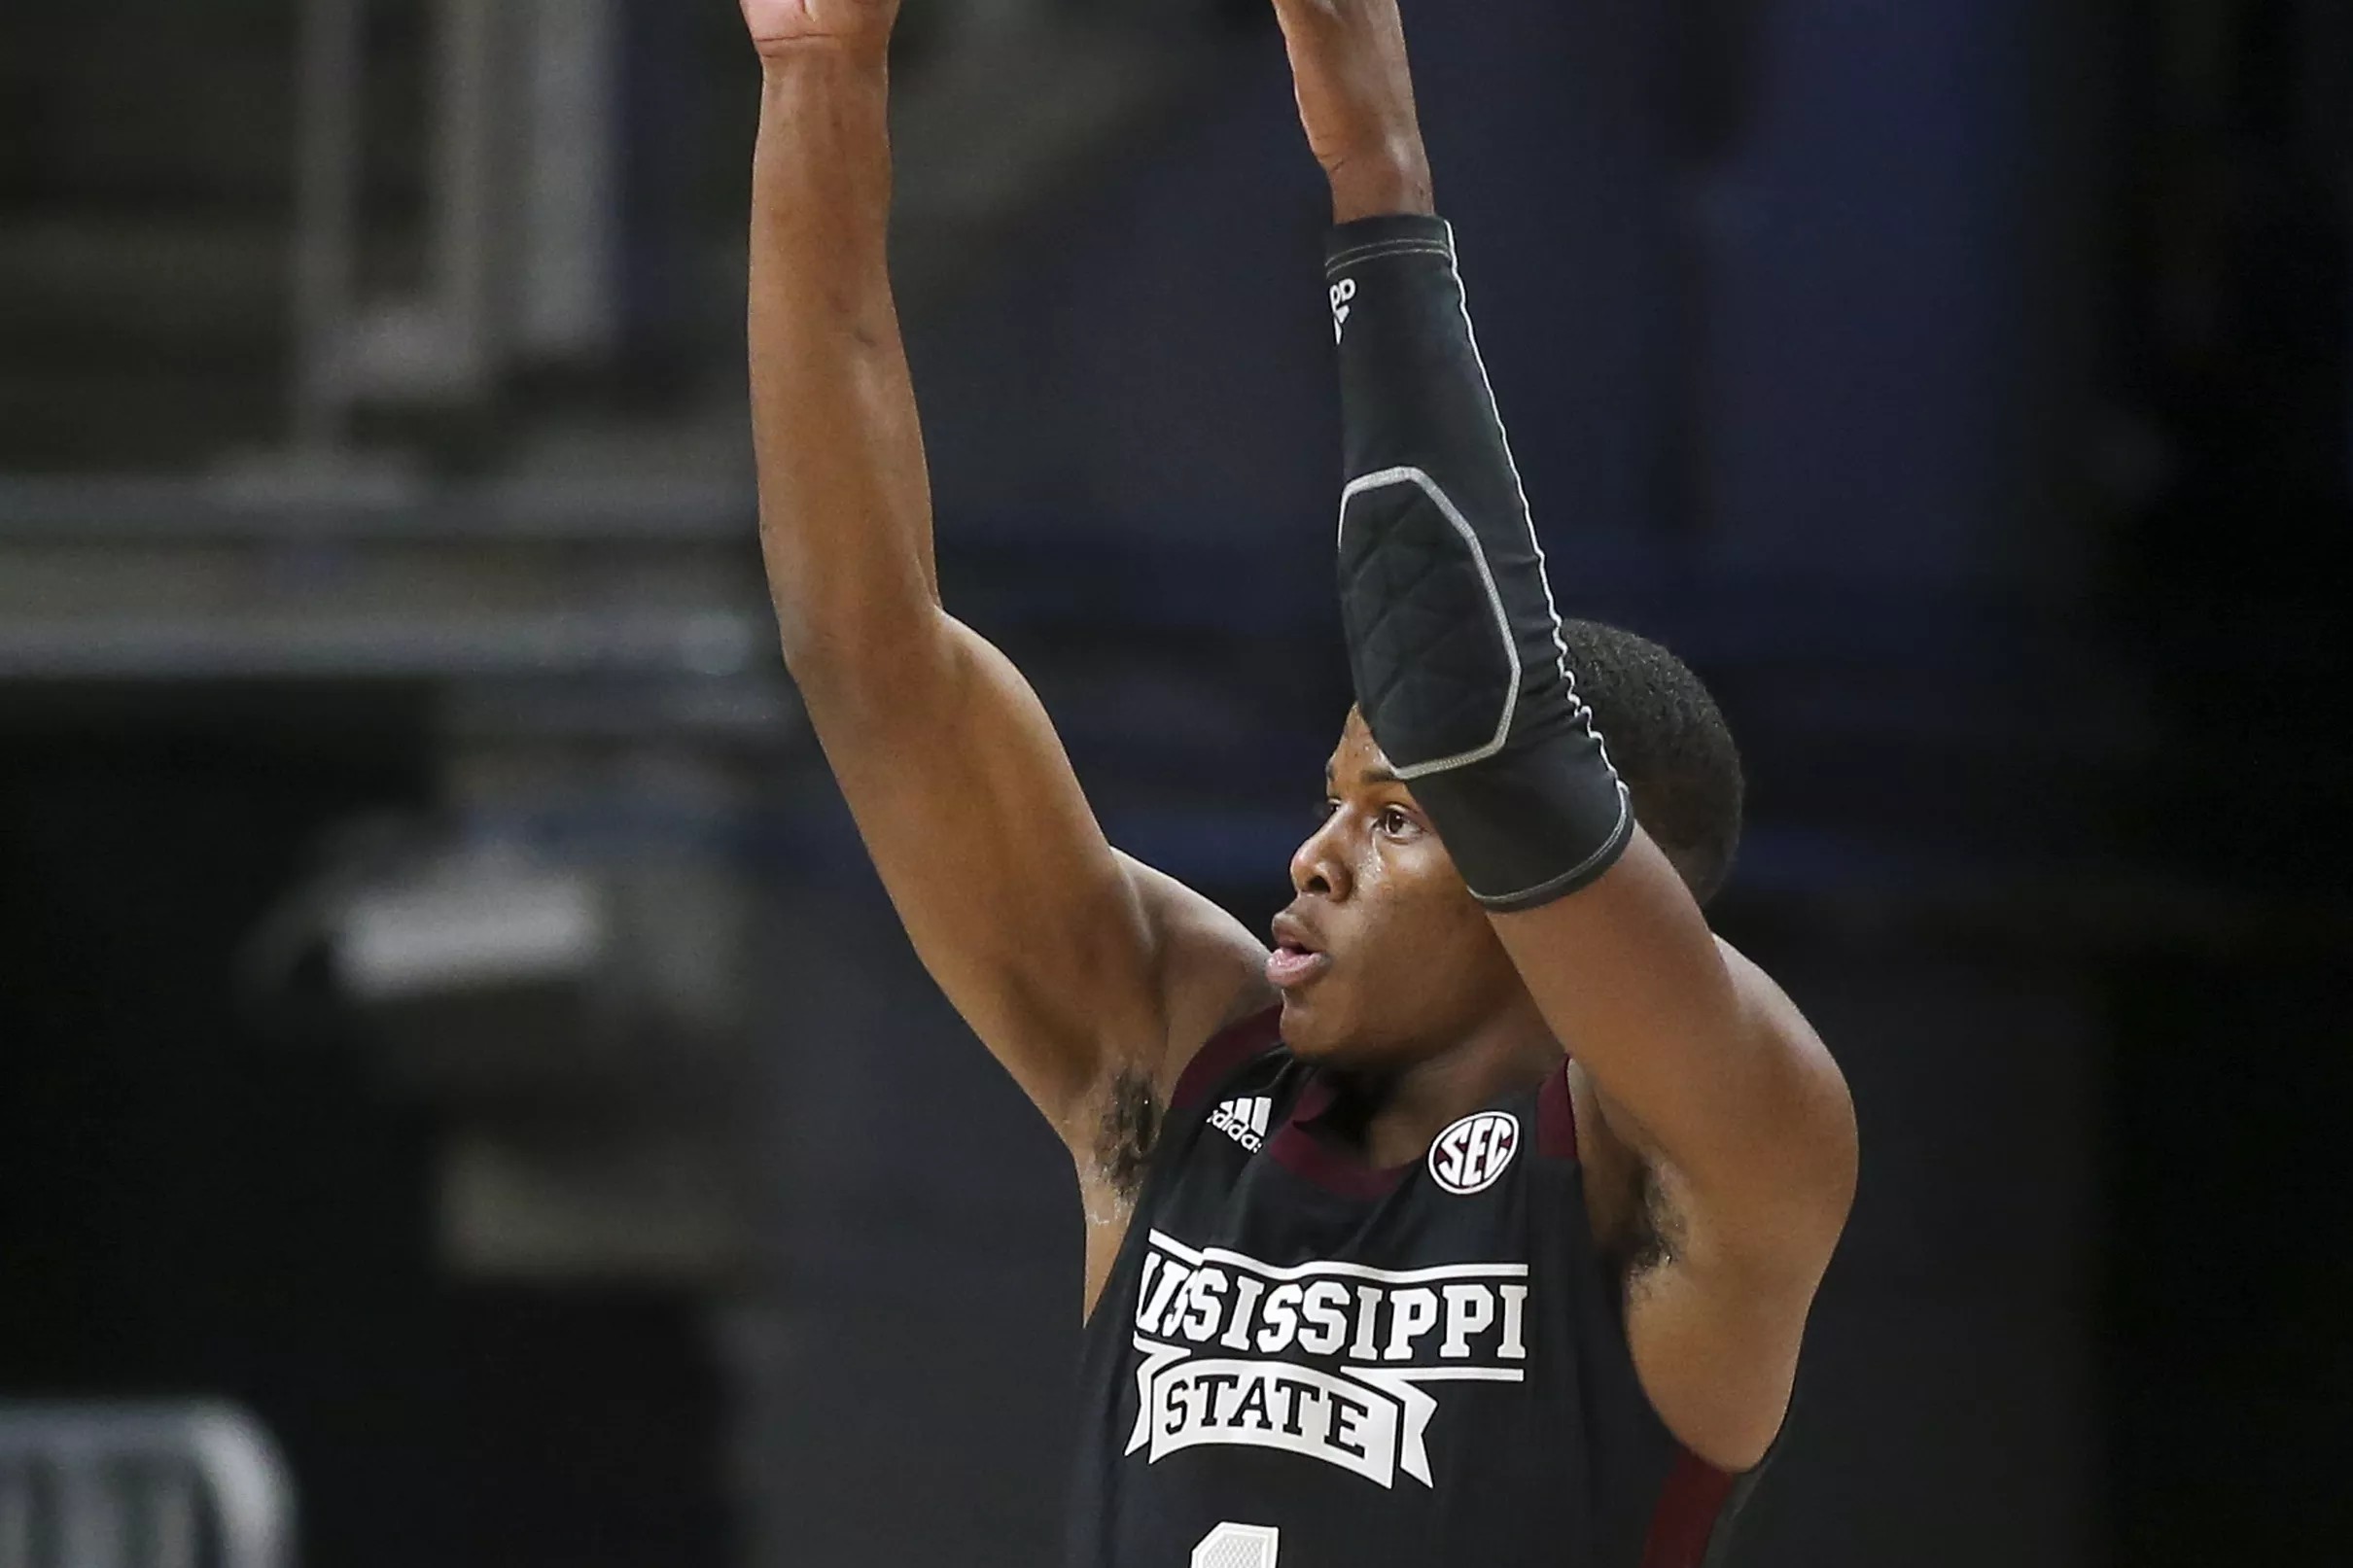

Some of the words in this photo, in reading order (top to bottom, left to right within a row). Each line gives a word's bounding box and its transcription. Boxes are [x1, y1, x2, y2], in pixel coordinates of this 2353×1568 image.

[1438, 1116, 1513, 1186] SEC
[1136, 1251, 1528, 1360] ISSISSIPPI
[1166, 1374, 1369, 1460] STATE
